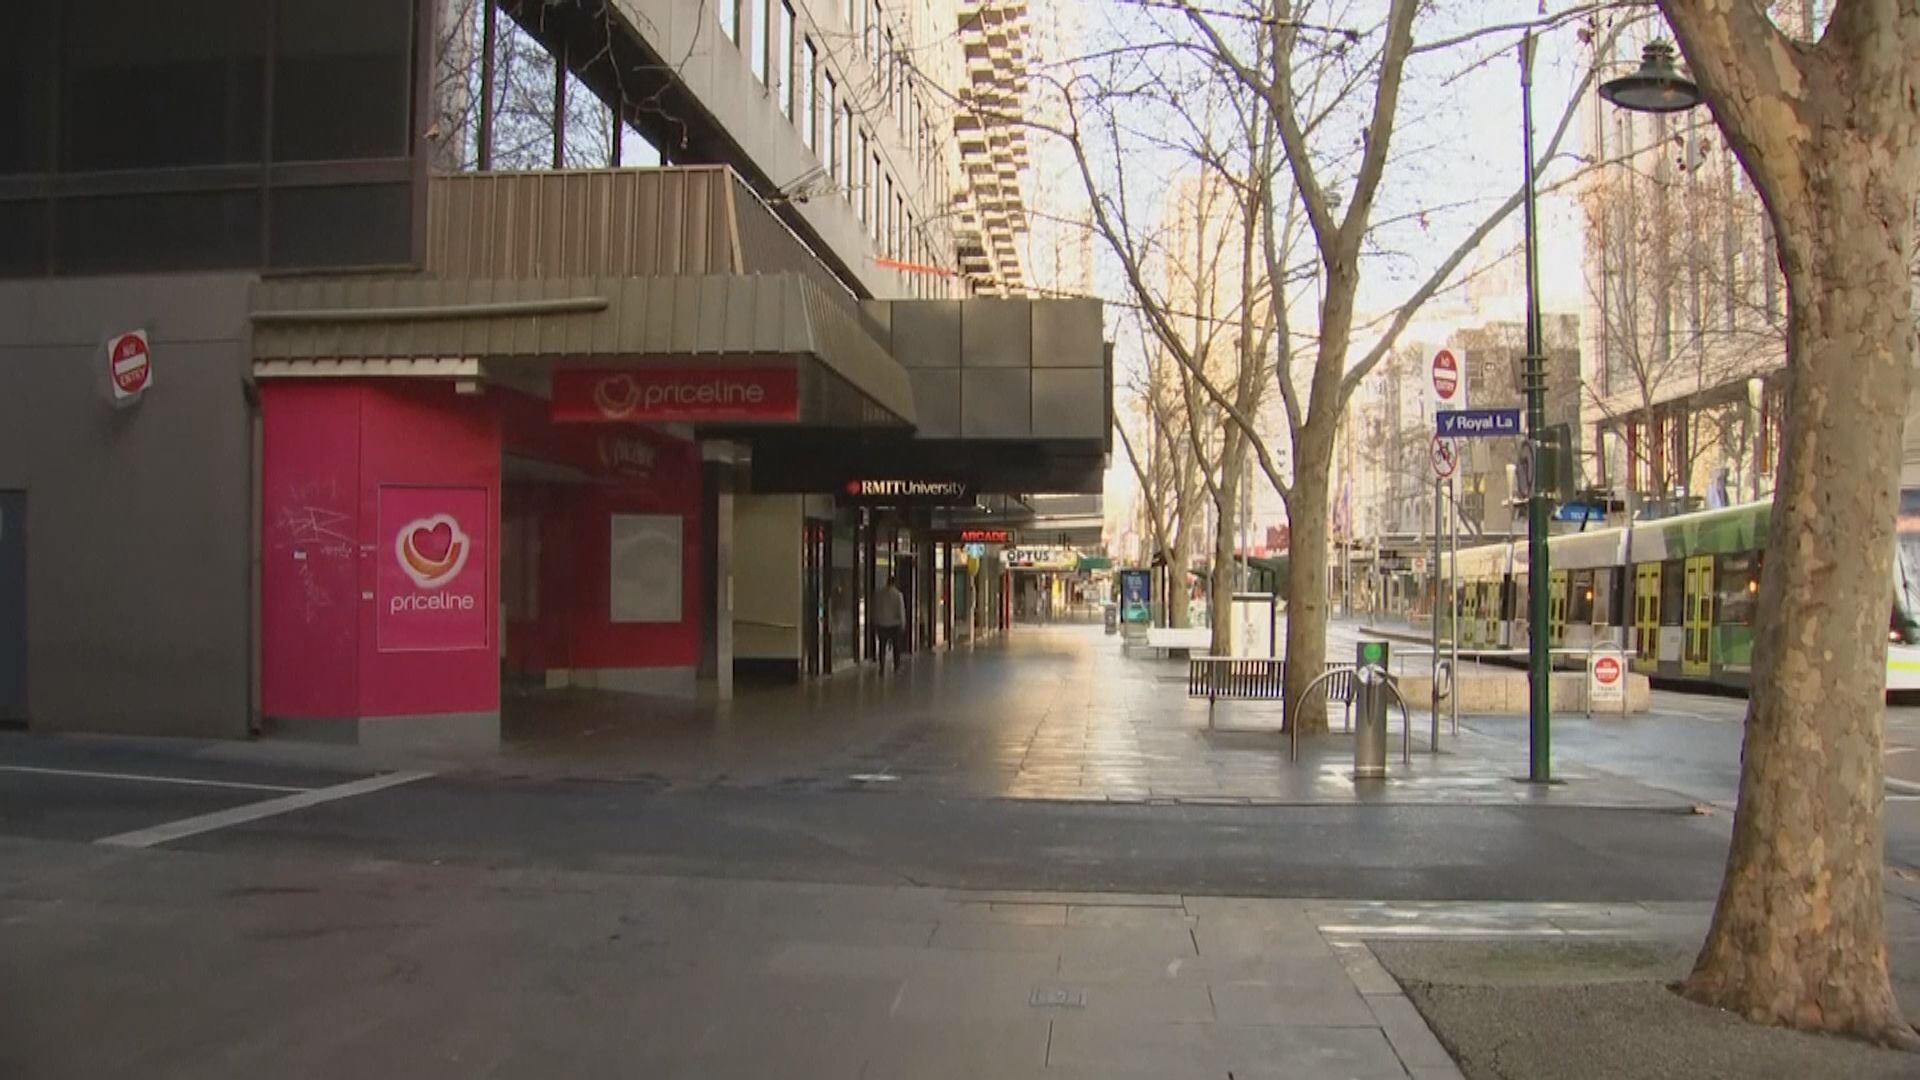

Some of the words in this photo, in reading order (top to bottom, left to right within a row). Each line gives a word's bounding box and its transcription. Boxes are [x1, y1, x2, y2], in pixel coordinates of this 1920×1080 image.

[645, 378, 764, 409] priceline
[1457, 415, 1494, 431] Royal
[1496, 415, 1513, 428] La
[961, 531, 1007, 541] ARCADE
[1007, 549, 1050, 561] OPTUS
[391, 592, 474, 615] priceline
